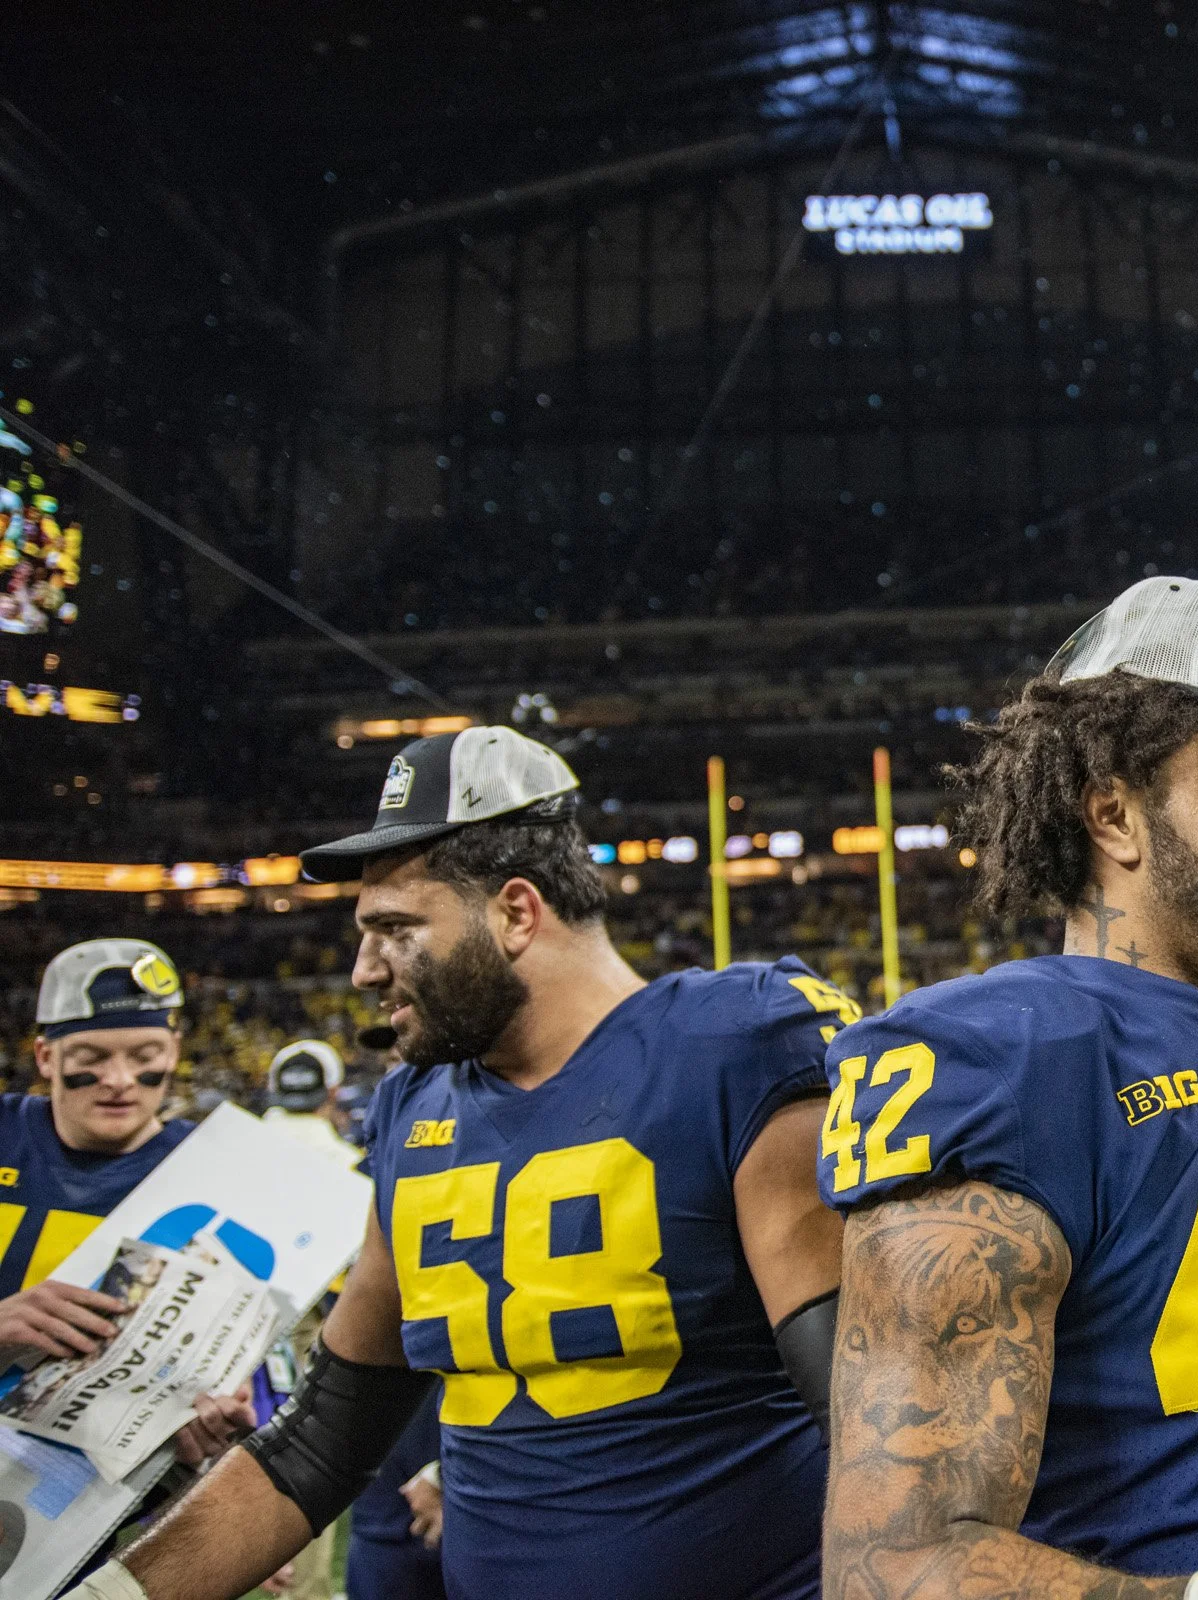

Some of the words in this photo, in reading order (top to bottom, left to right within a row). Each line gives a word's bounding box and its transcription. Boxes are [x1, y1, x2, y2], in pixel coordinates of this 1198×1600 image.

[802, 194, 925, 231] LUCAS
[821, 1042, 936, 1193] 42
[52, 1270, 205, 1433] MICH-AGAIN!
[391, 1137, 683, 1427] 58
[116, 1407, 154, 1449] STAR
